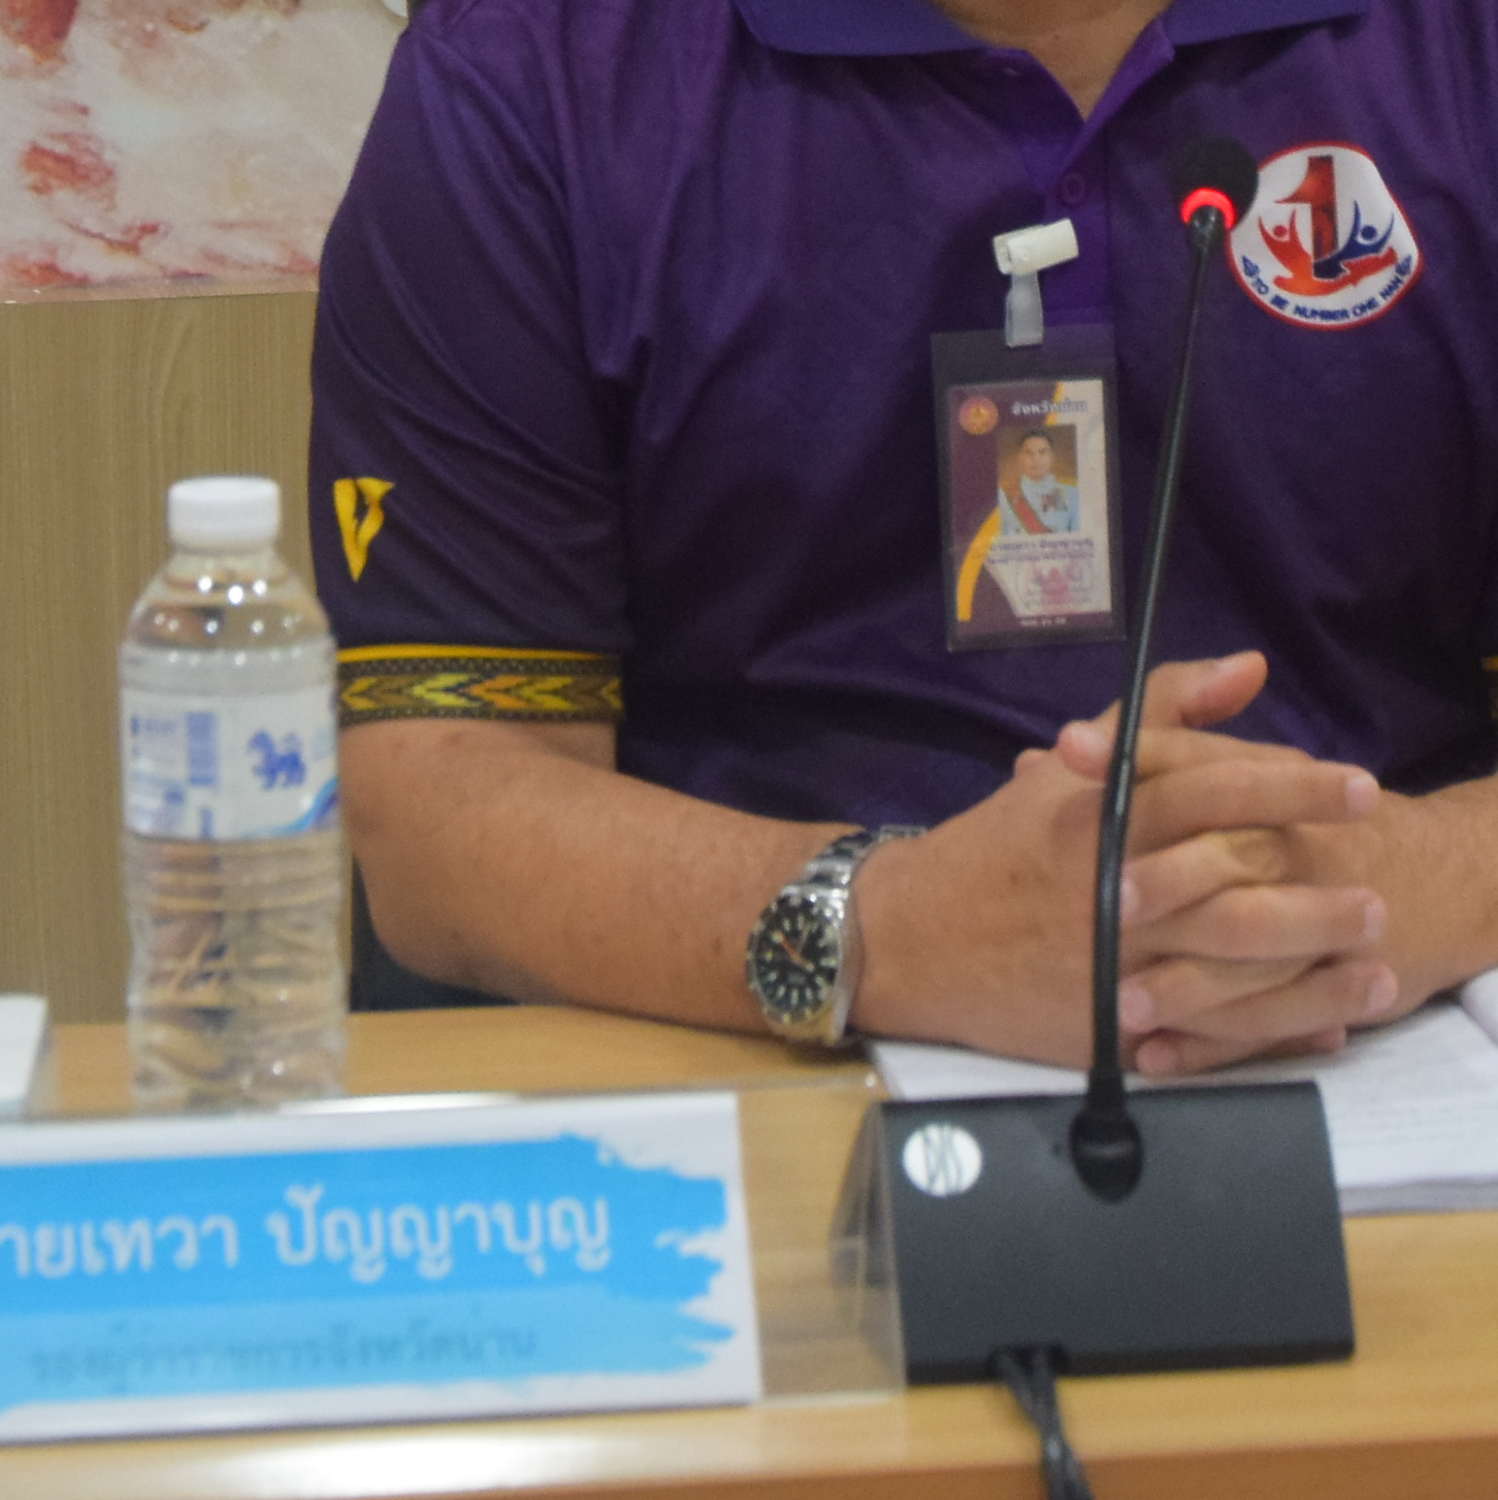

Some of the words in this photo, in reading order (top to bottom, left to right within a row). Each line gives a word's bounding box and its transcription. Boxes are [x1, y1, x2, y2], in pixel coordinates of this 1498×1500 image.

[1254, 277, 1269, 295] TO
[1294, 304, 1350, 321] NUMBER
[1352, 297, 1379, 317] ONE
[264, 1181, 611, 1284] ปัญญาบุญ
